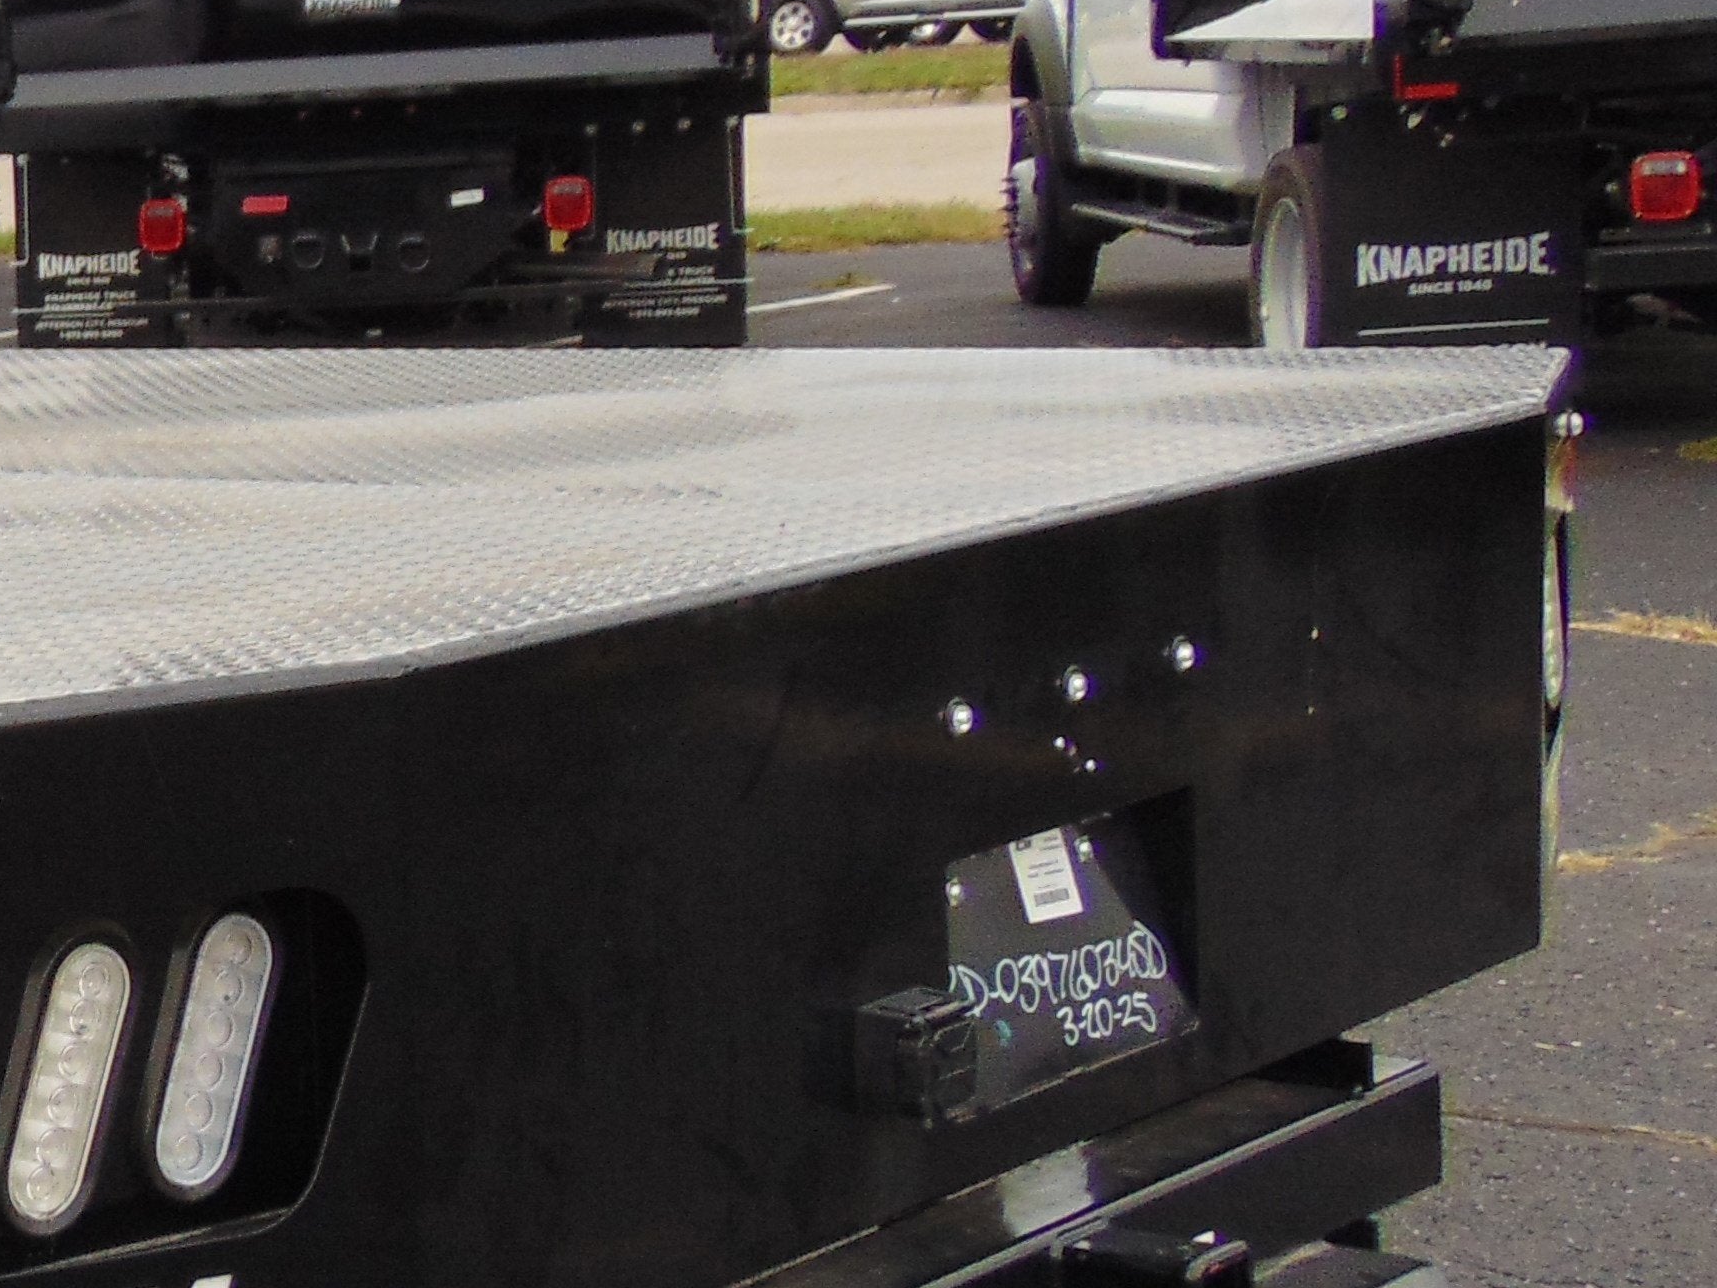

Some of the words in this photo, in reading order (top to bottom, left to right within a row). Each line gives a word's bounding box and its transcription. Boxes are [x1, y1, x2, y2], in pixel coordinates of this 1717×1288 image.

[606, 221, 720, 255] KNAPHEIDE
[38, 248, 142, 280] KNAPHEIDE
[1356, 230, 1551, 289] KNAPHEIDE
[1407, 281, 1454, 297] SINCE
[1055, 991, 1158, 1047] 3-20-25
